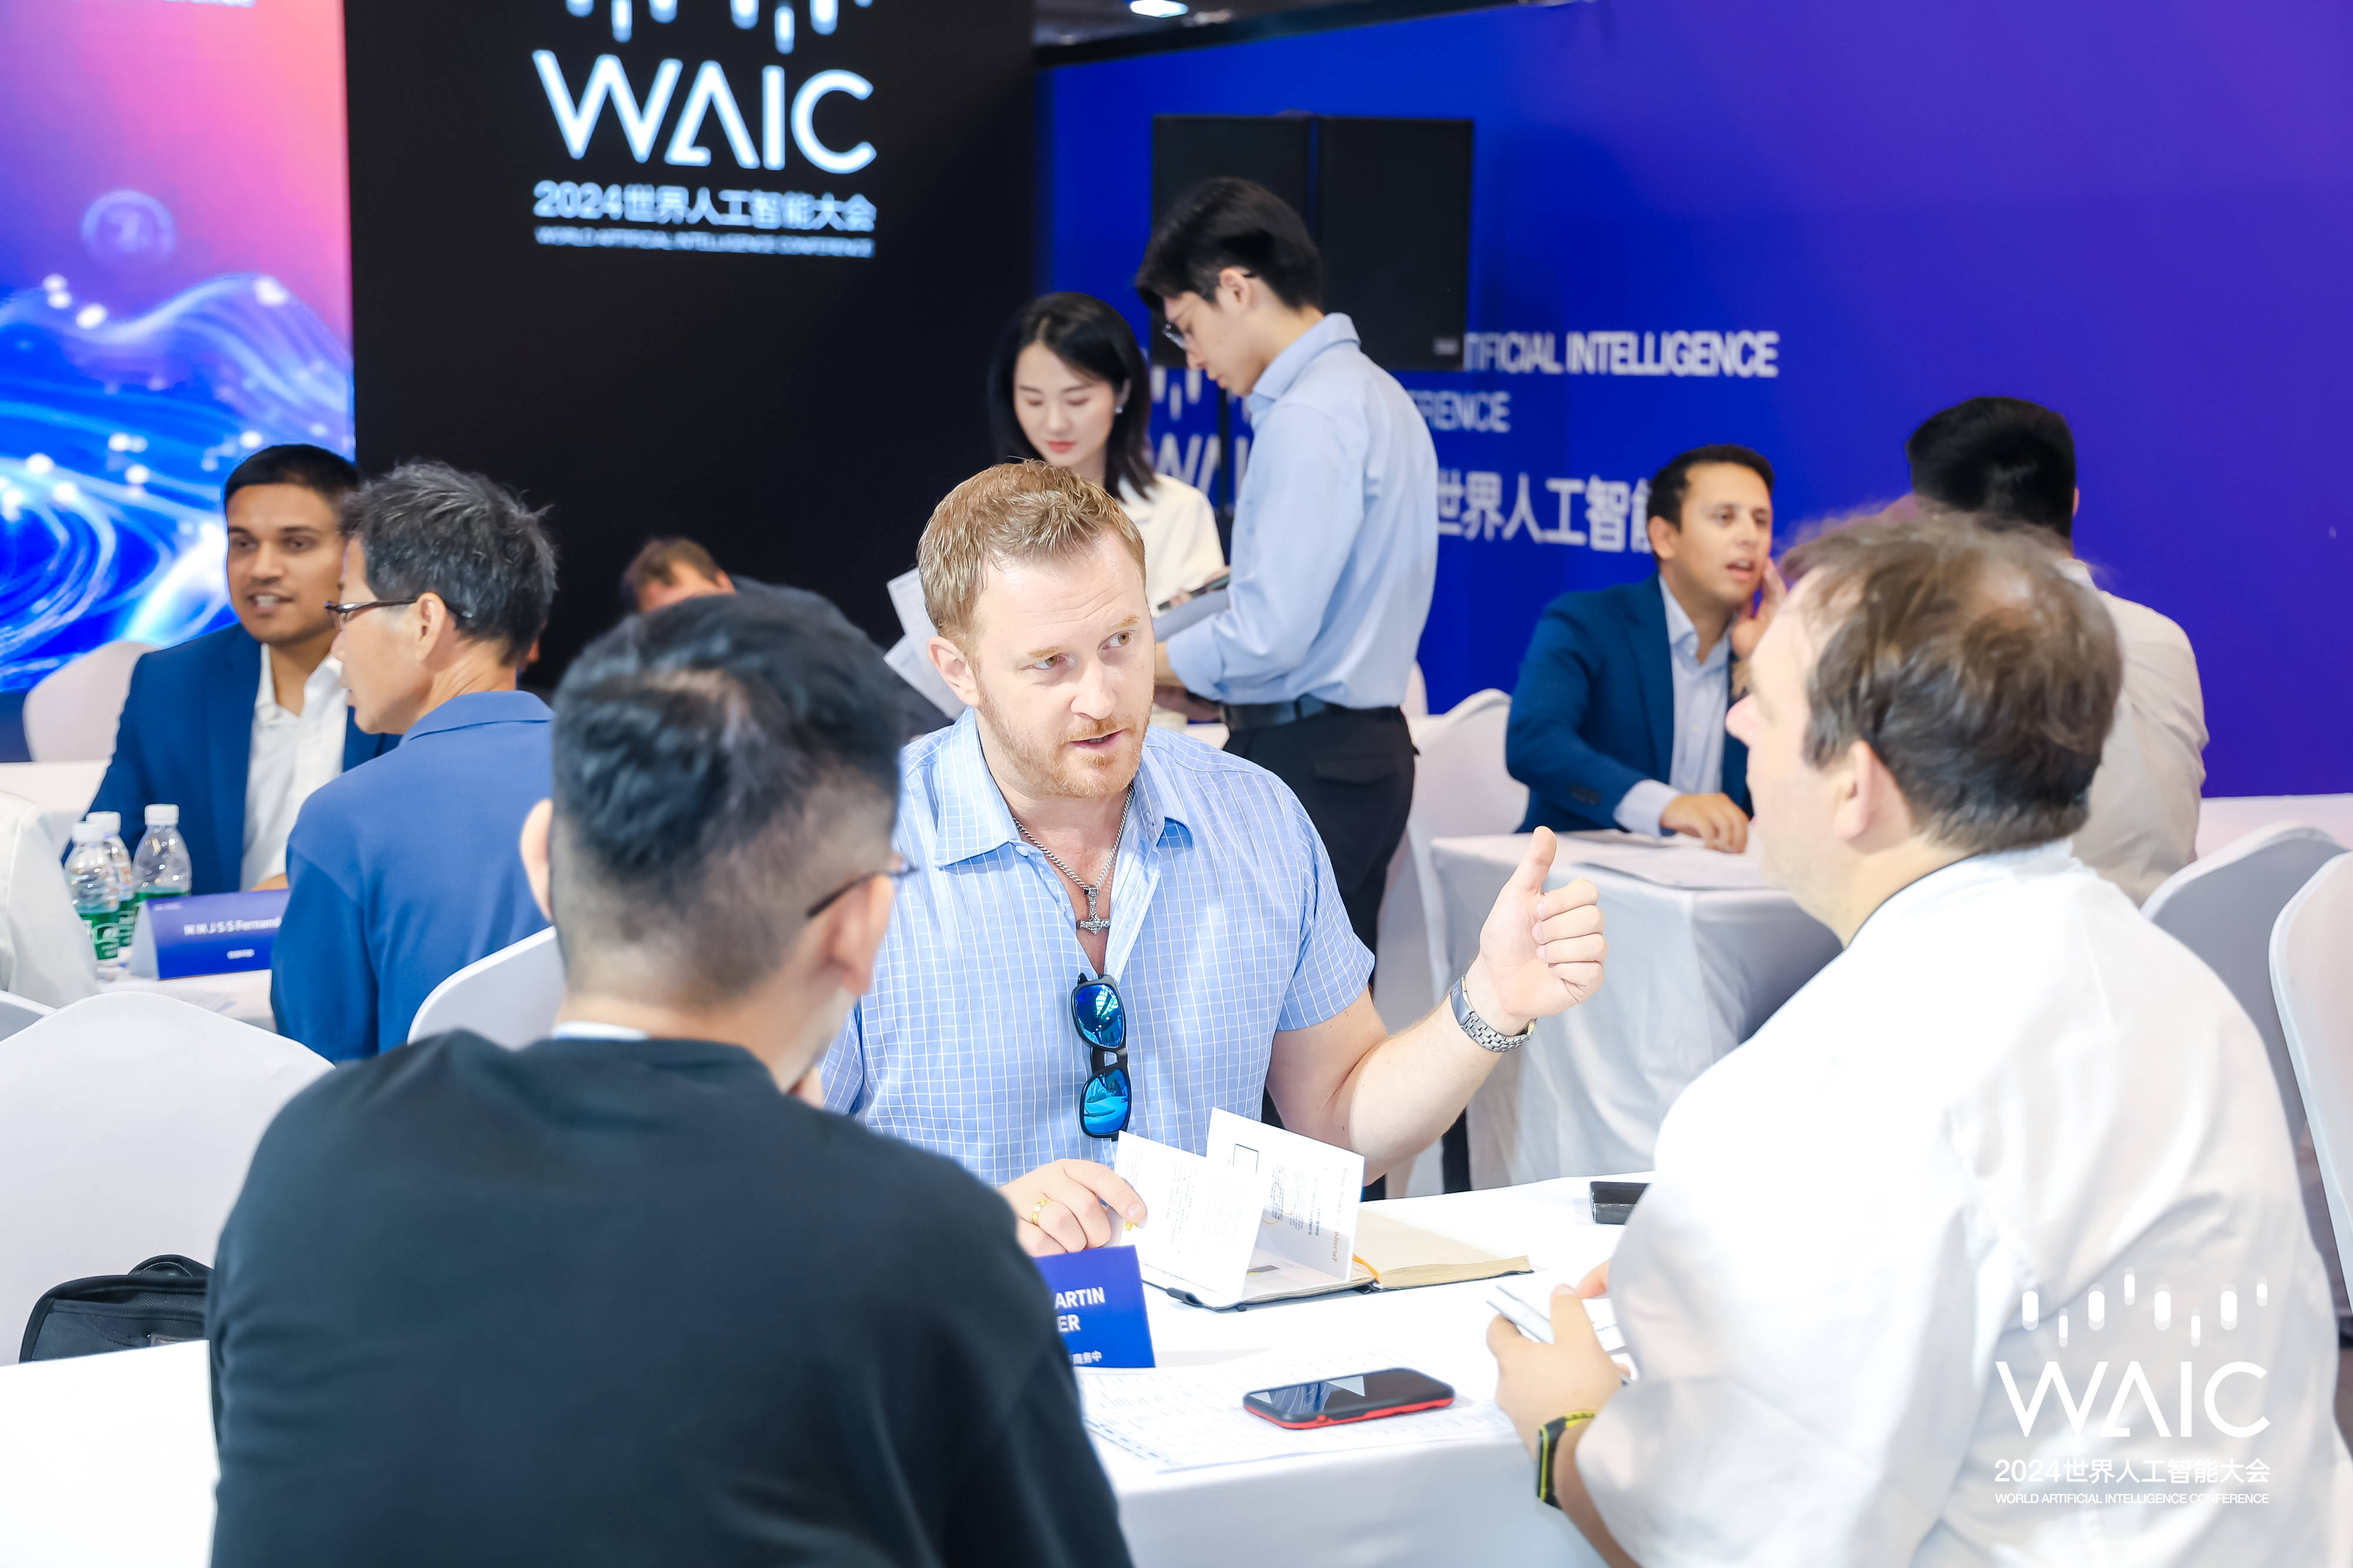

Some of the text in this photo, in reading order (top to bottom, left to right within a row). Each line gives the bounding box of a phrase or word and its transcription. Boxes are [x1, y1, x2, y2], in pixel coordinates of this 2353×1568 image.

[532, 49, 876, 174] WAIC
[533, 180, 876, 232] 2024世界人工智能大会
[1565, 331, 1780, 378] INTELLIGENCE
[1055, 1286, 1105, 1309] ARTIN
[1058, 1314, 1081, 1332] ER
